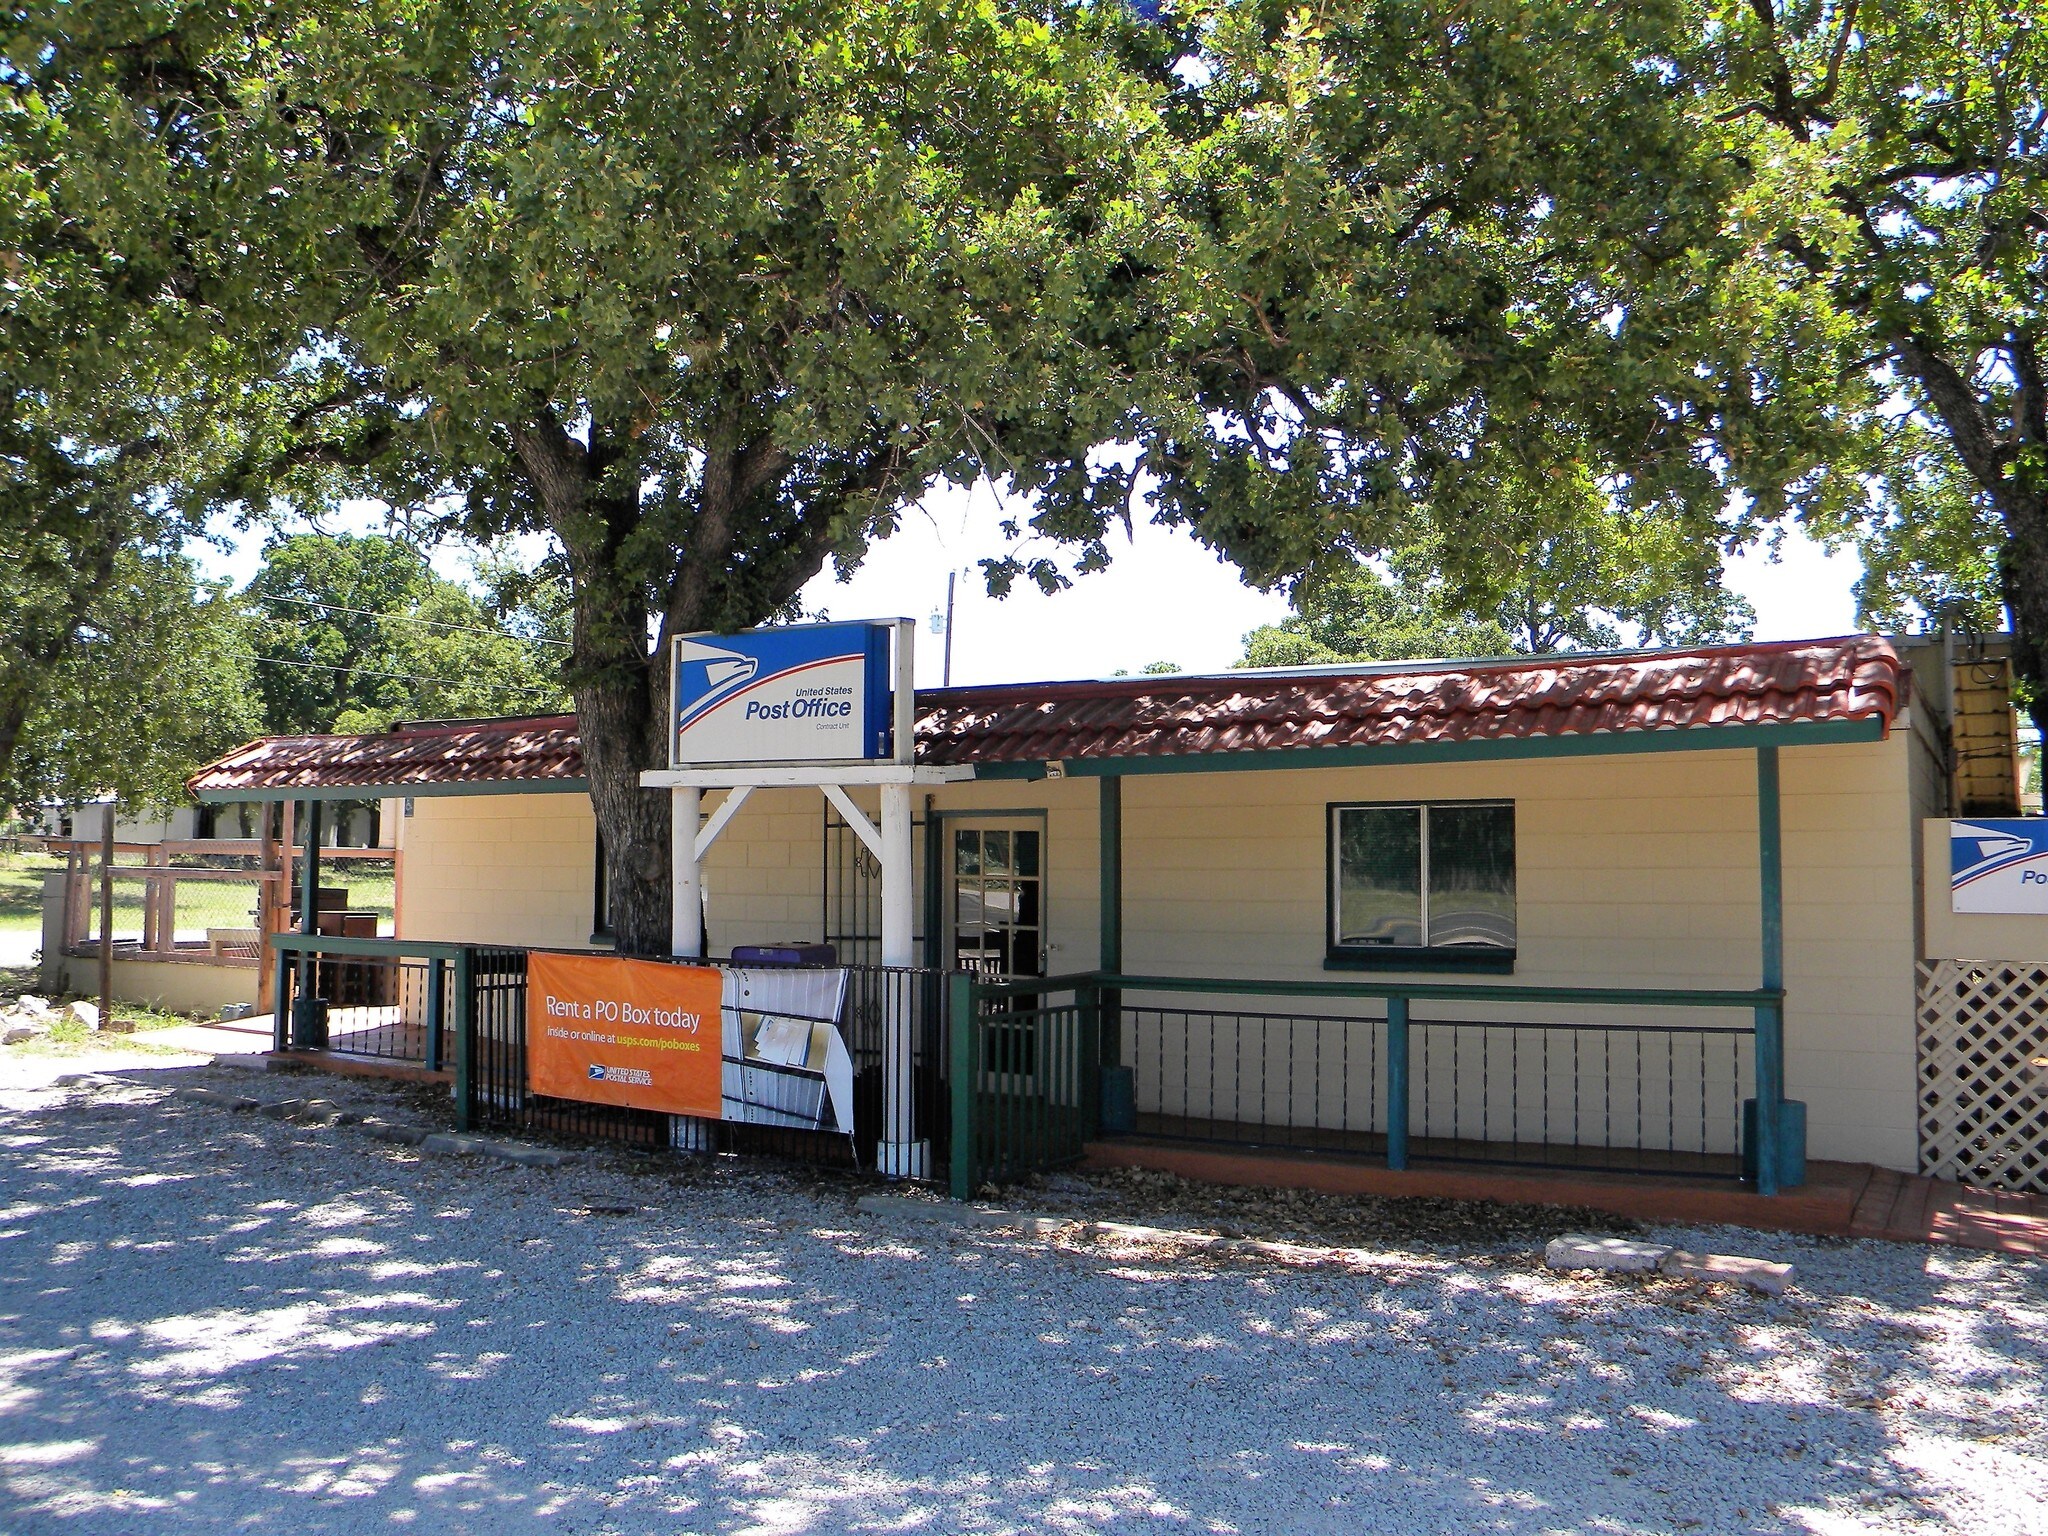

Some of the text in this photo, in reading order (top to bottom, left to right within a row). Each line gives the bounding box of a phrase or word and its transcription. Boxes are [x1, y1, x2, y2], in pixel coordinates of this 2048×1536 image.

[795, 686, 853, 697] United States
[745, 697, 852, 720] Post Office
[816, 722, 850, 731] Contract Unit
[2021, 870, 2048, 885] Po
[546, 995, 701, 1034] Rent a PO Box today
[547, 1026, 701, 1052] inside or online at usps.com/poboxes
[606, 1066, 651, 1078] UNITED STATES
[606, 1074, 653, 1086] POSTAL SERVICE
